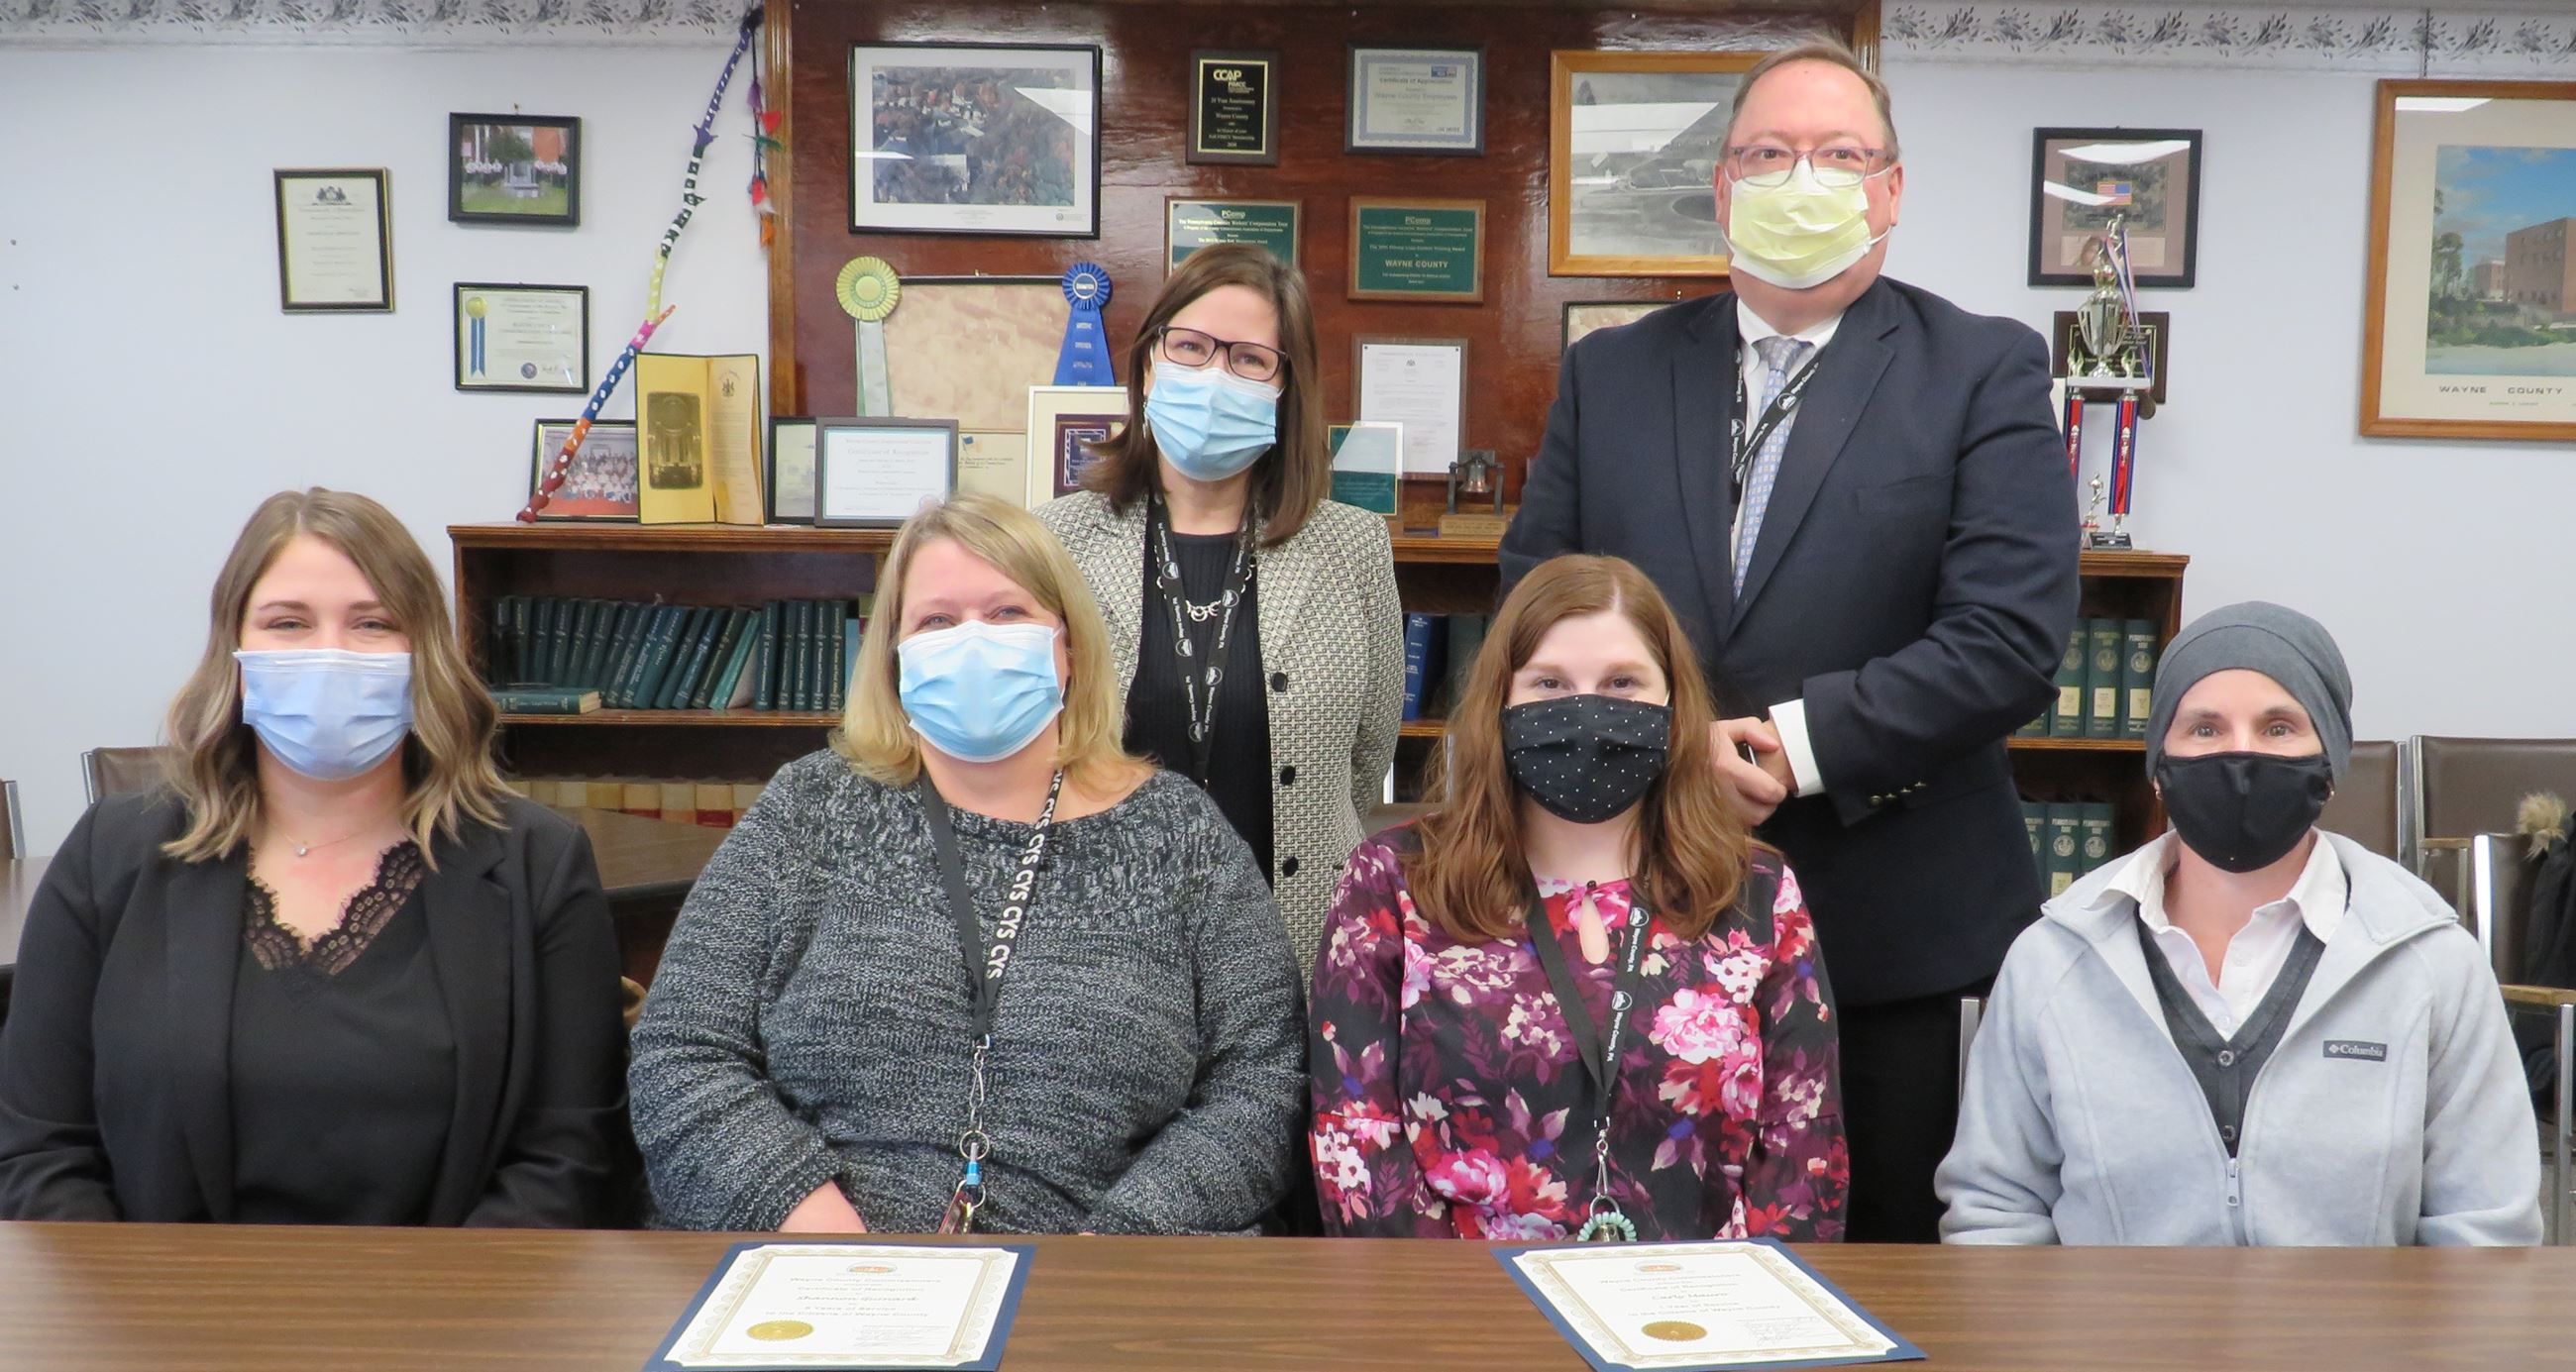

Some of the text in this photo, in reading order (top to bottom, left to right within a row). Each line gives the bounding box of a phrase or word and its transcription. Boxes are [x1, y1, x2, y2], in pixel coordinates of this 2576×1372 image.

[1214, 69, 1241, 81] CCAP
[1385, 260, 1413, 268] WAYNE
[1022, 833, 1045, 866] CYS
[1010, 869, 1034, 901] CYS
[997, 905, 1023, 939] CYS
[1632, 927, 1641, 945] Wayne
[986, 944, 1011, 980] CYS
[1614, 1011, 1624, 1029] Wayne
[2340, 1044, 2383, 1057] Columbia
